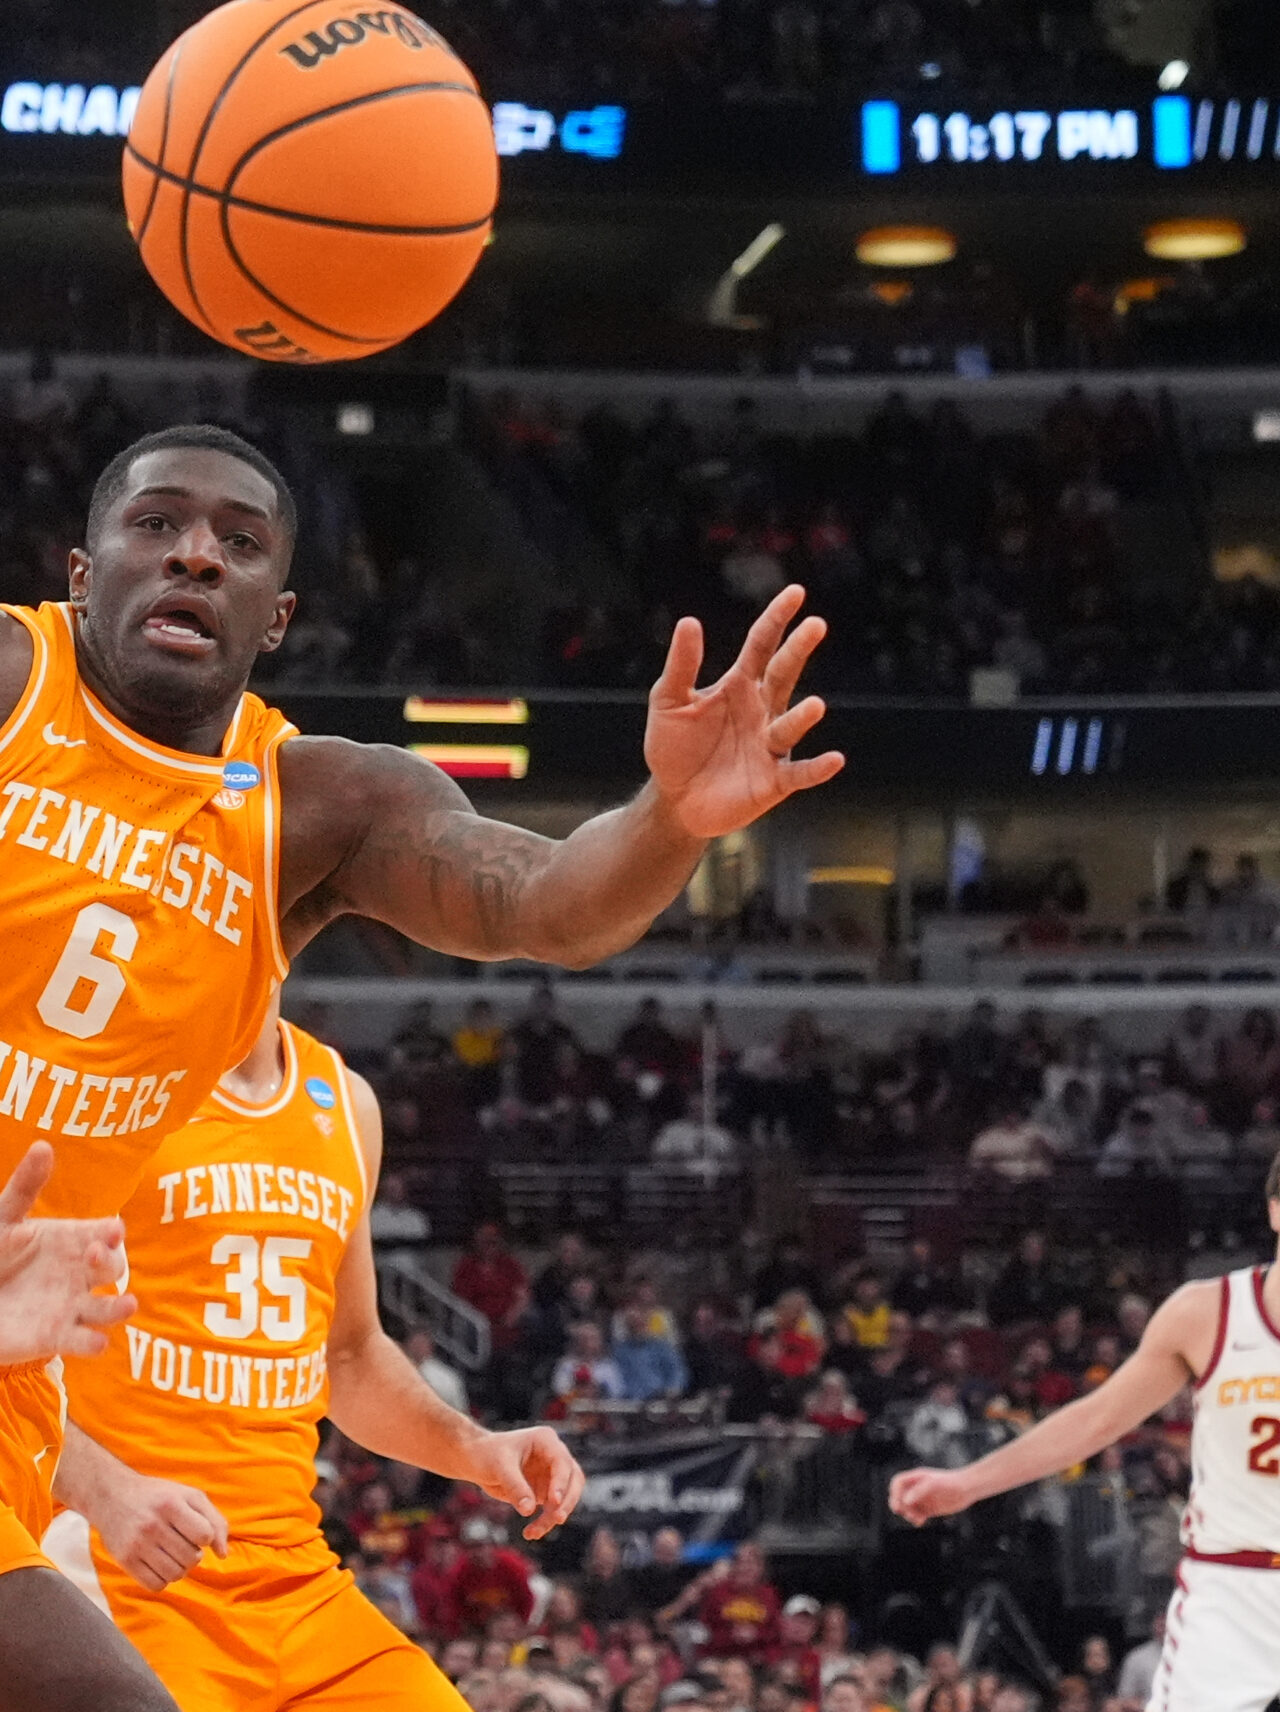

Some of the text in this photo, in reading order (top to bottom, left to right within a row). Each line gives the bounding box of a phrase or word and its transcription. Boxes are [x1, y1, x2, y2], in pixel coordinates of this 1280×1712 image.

[912, 109, 1139, 163] 11:17 PM
[36, 902, 139, 1040] 6
[158, 1163, 354, 1243] TENNESSEE
[203, 1234, 313, 1342] 35
